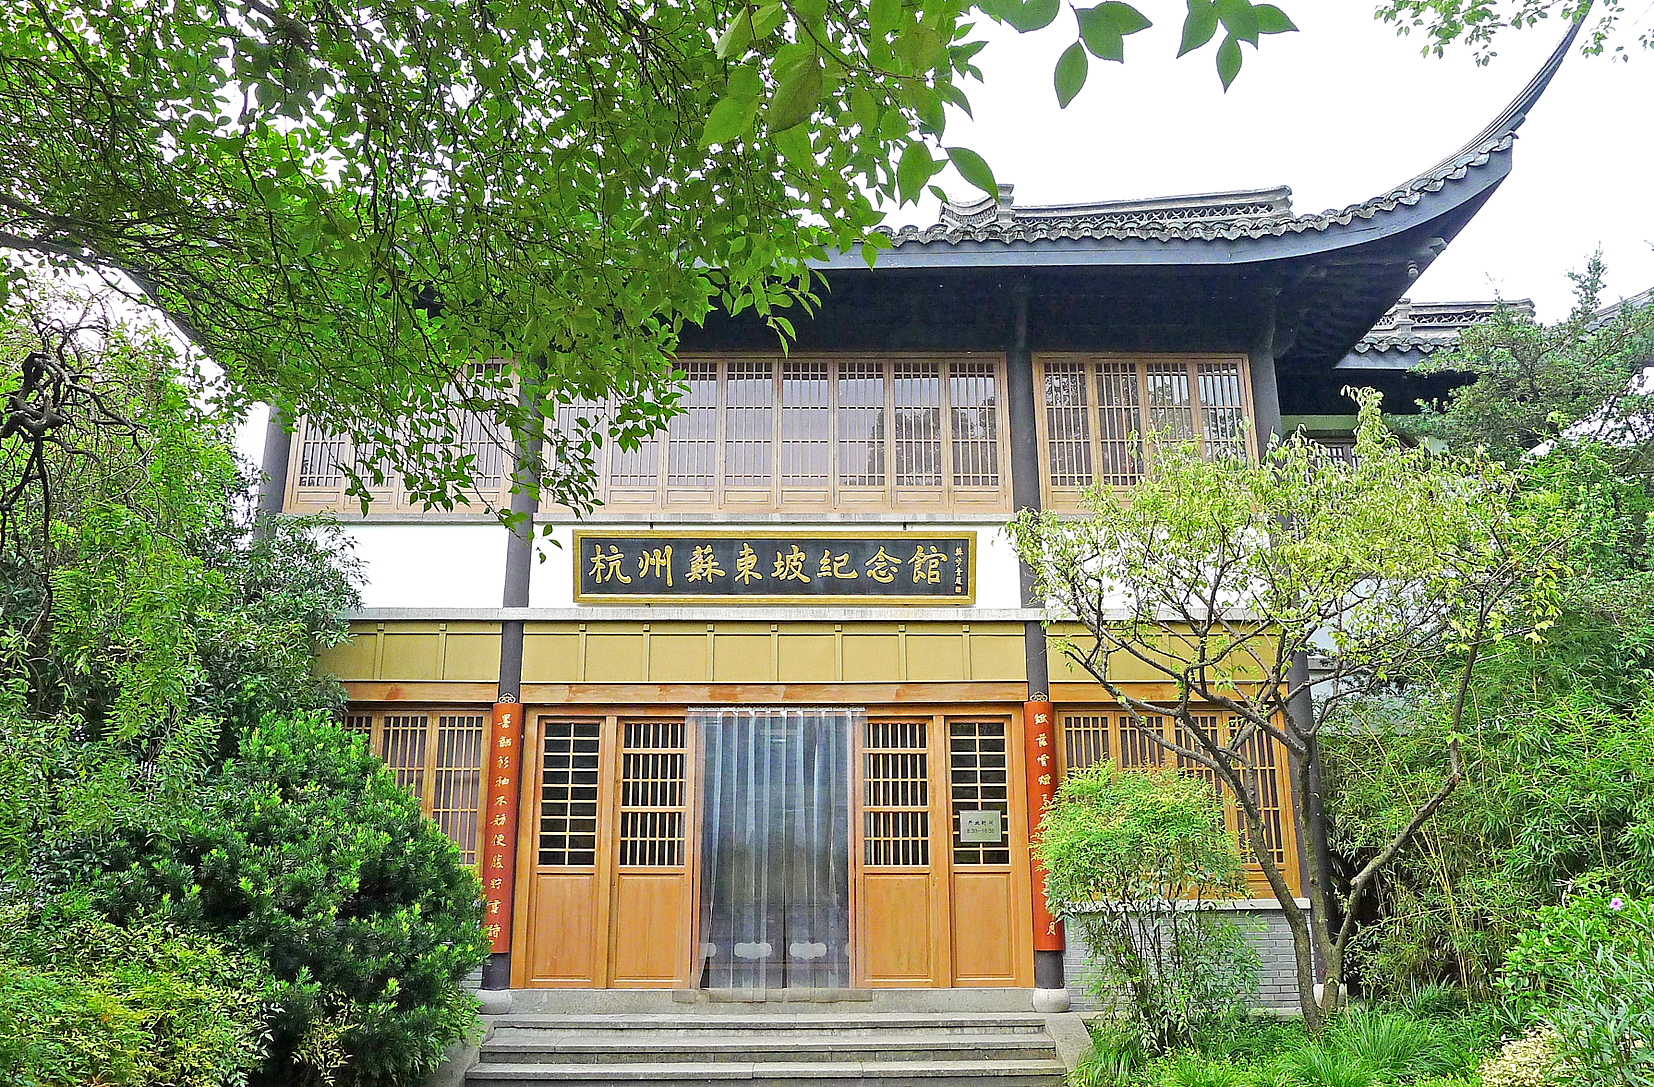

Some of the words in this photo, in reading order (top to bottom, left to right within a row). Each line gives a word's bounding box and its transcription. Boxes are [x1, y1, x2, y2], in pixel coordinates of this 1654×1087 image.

[587, 543, 948, 587] 杭州蘇東坡紀念館
